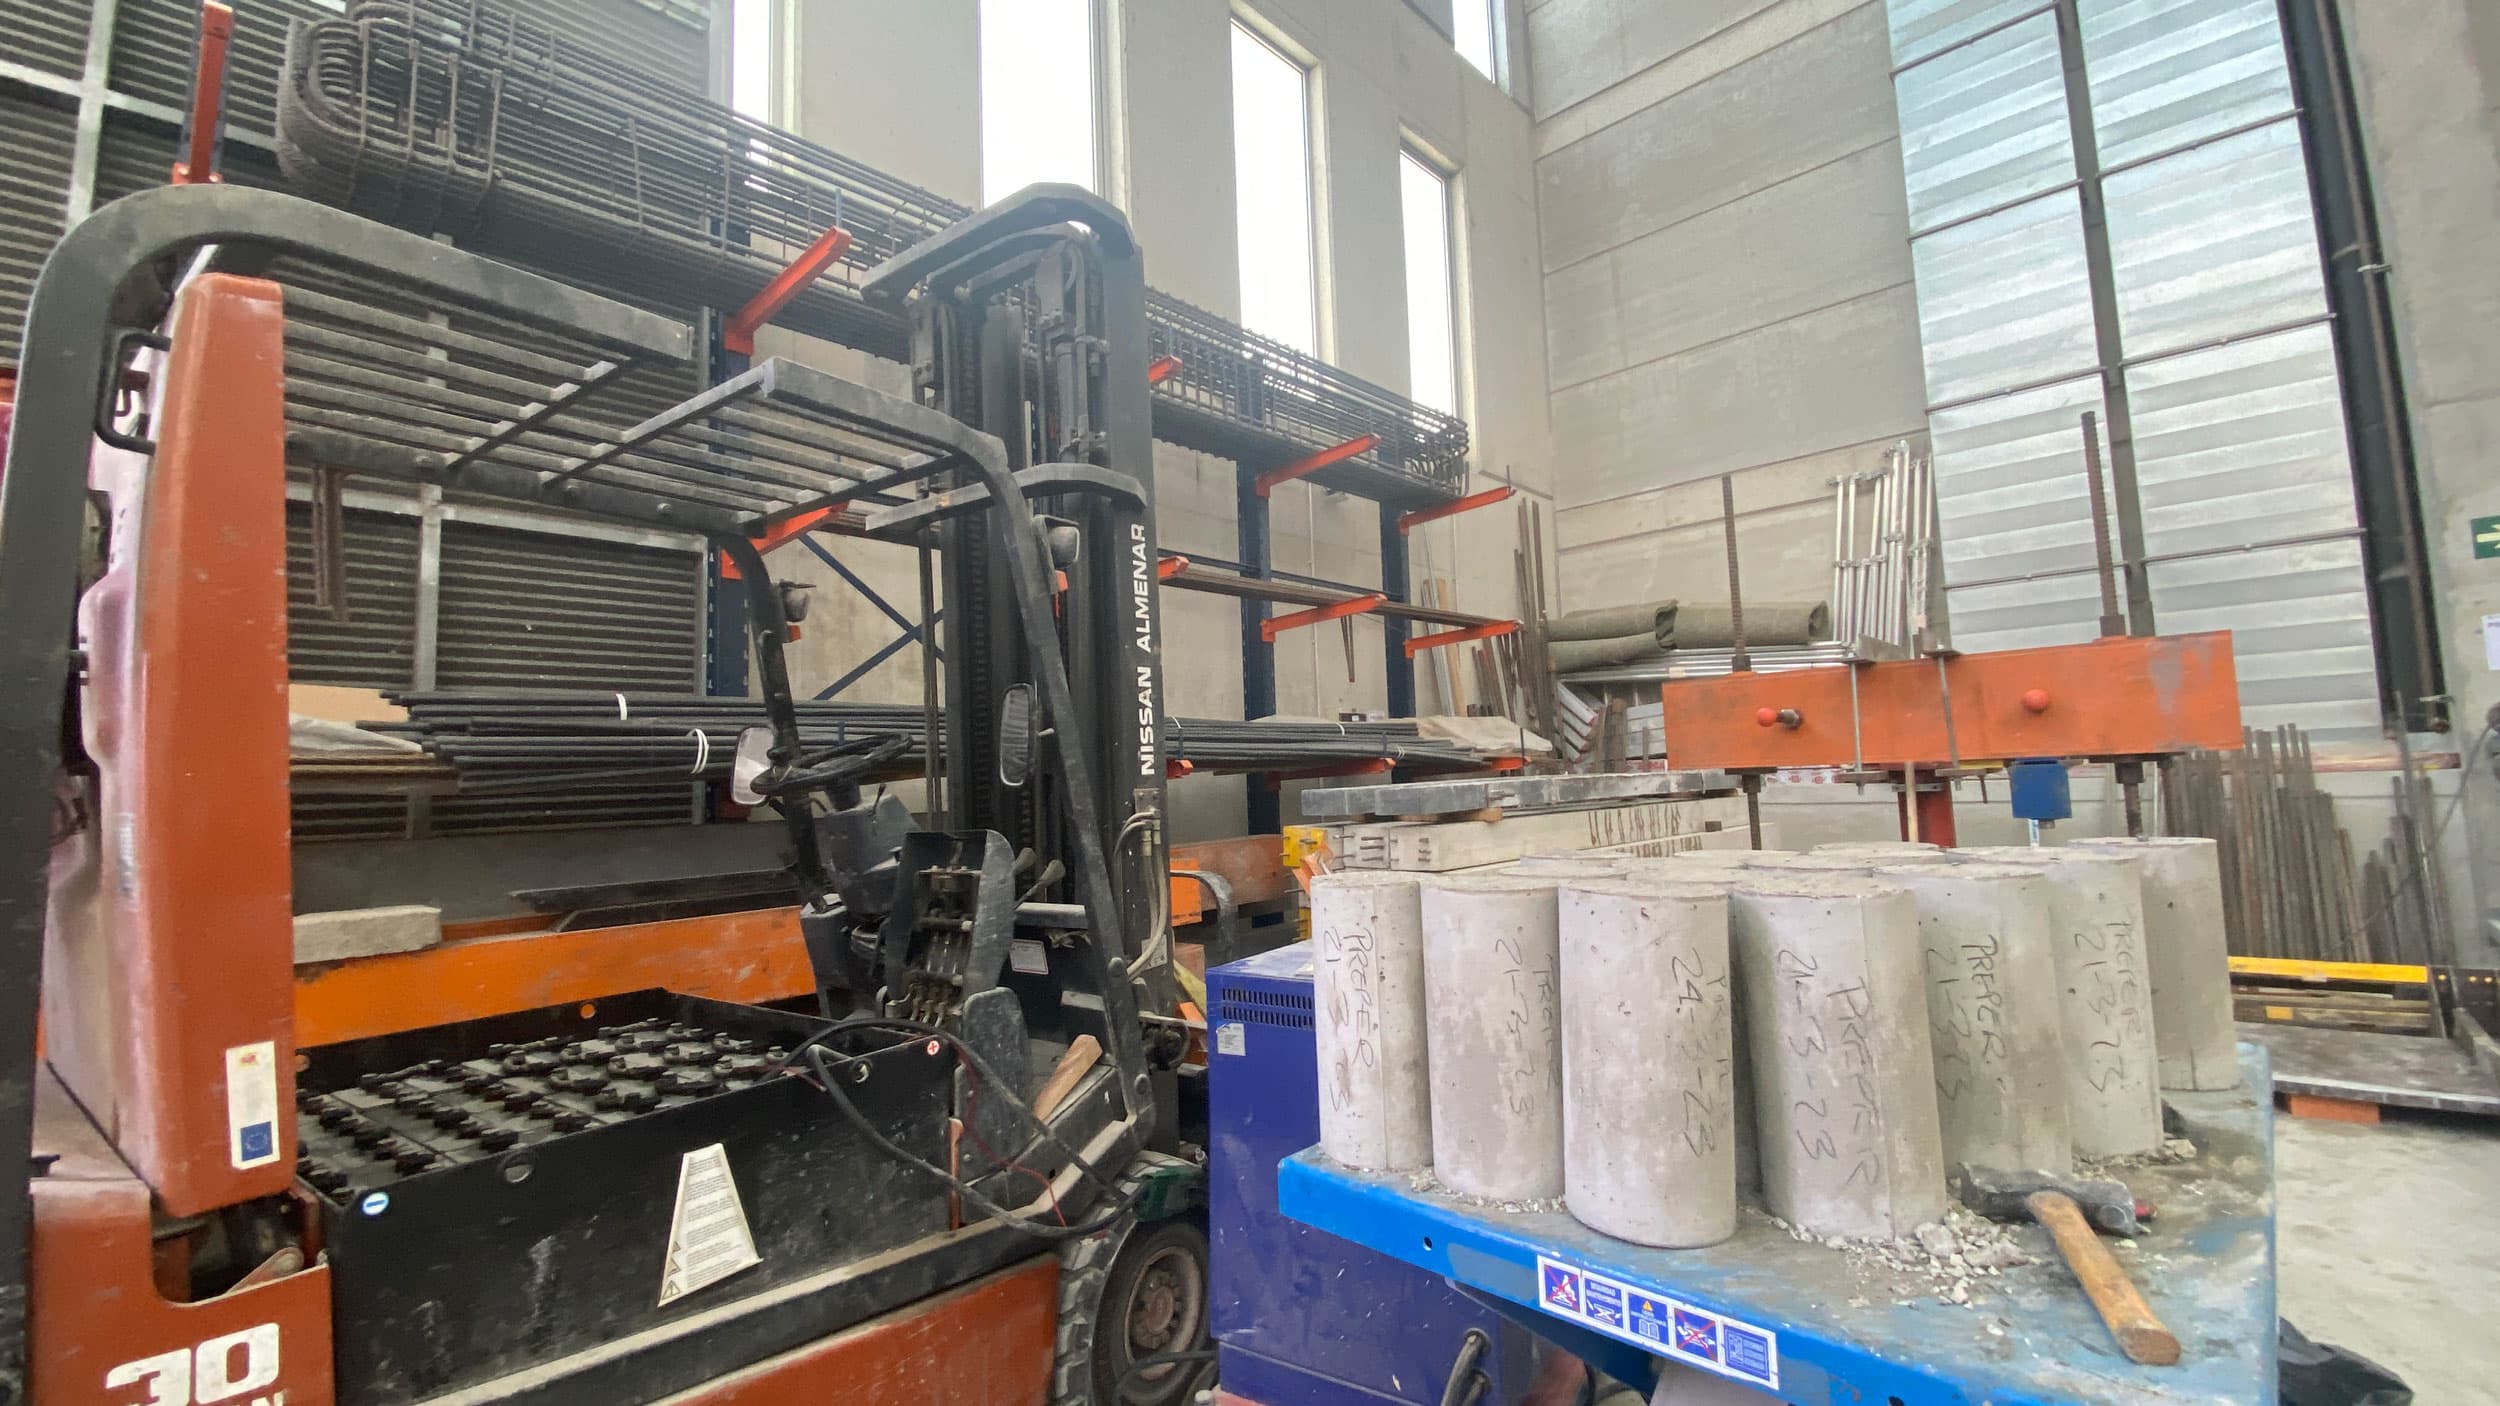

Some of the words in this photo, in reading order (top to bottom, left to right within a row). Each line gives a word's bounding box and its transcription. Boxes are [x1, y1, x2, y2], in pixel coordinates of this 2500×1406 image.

[1130, 523, 1152, 653] ALMENAR
[1135, 666, 1155, 776] NISSAN
[105, 1322, 280, 1406] 30
